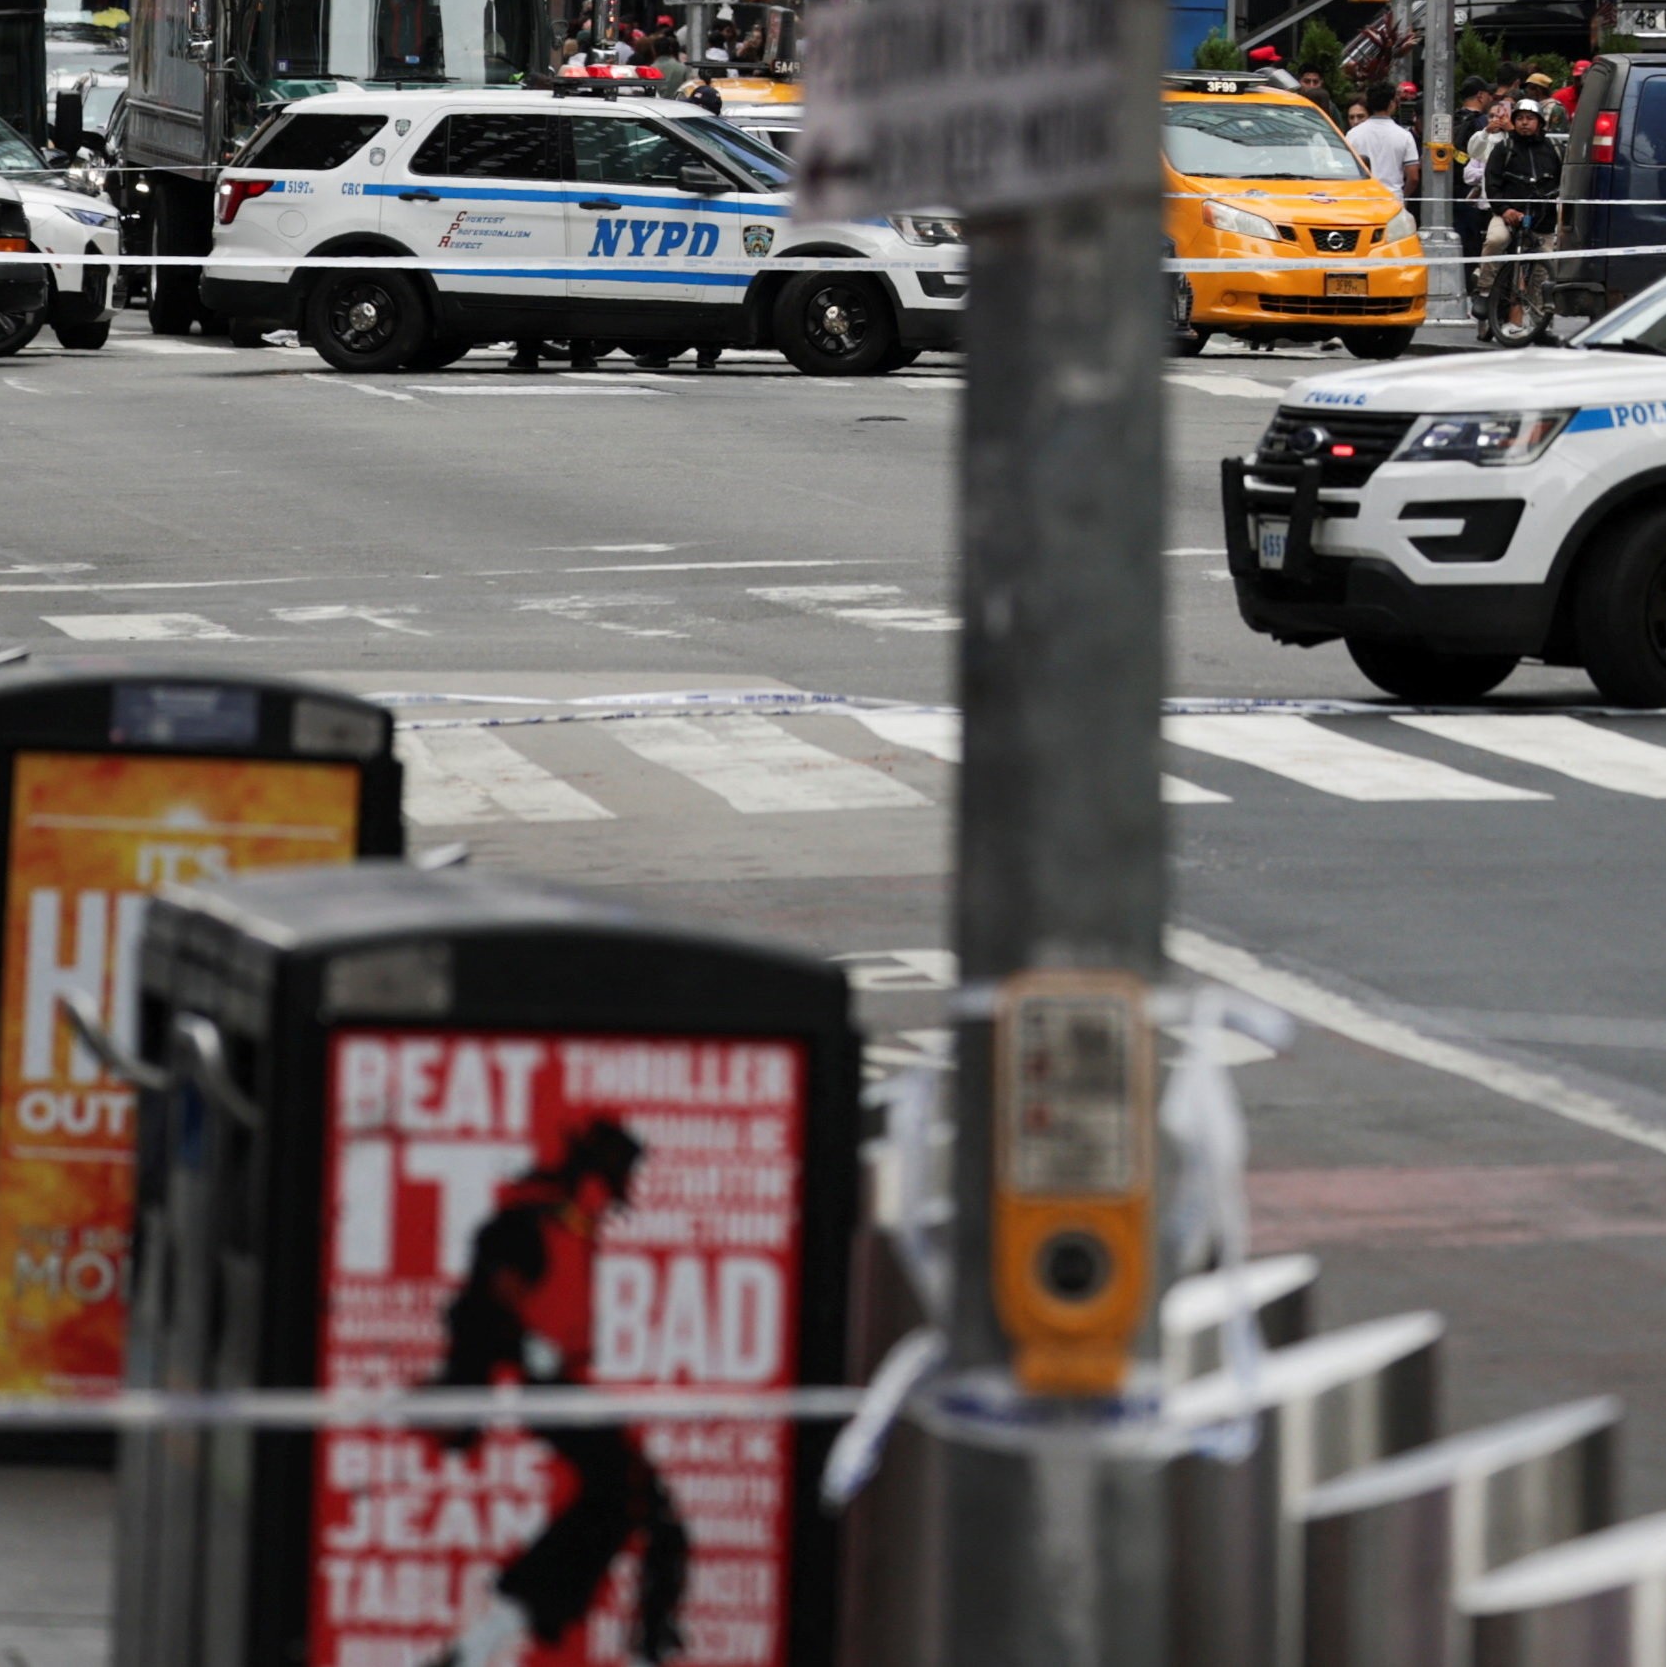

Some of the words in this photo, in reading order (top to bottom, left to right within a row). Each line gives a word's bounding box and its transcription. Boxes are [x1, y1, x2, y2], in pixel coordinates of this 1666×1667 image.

[1636, 12, 1657, 29] 45
[1207, 81, 1237, 92] 3F99
[288, 181, 309, 193] 5197
[342, 183, 360, 195] CRC
[588, 218, 720, 259] NYPD
[339, 1037, 547, 1132] BEAT
[560, 1042, 794, 1106] THRILLER
[17, 1091, 133, 1135] OUT
[337, 1137, 535, 1277] IT
[589, 1252, 782, 1387] BAD
